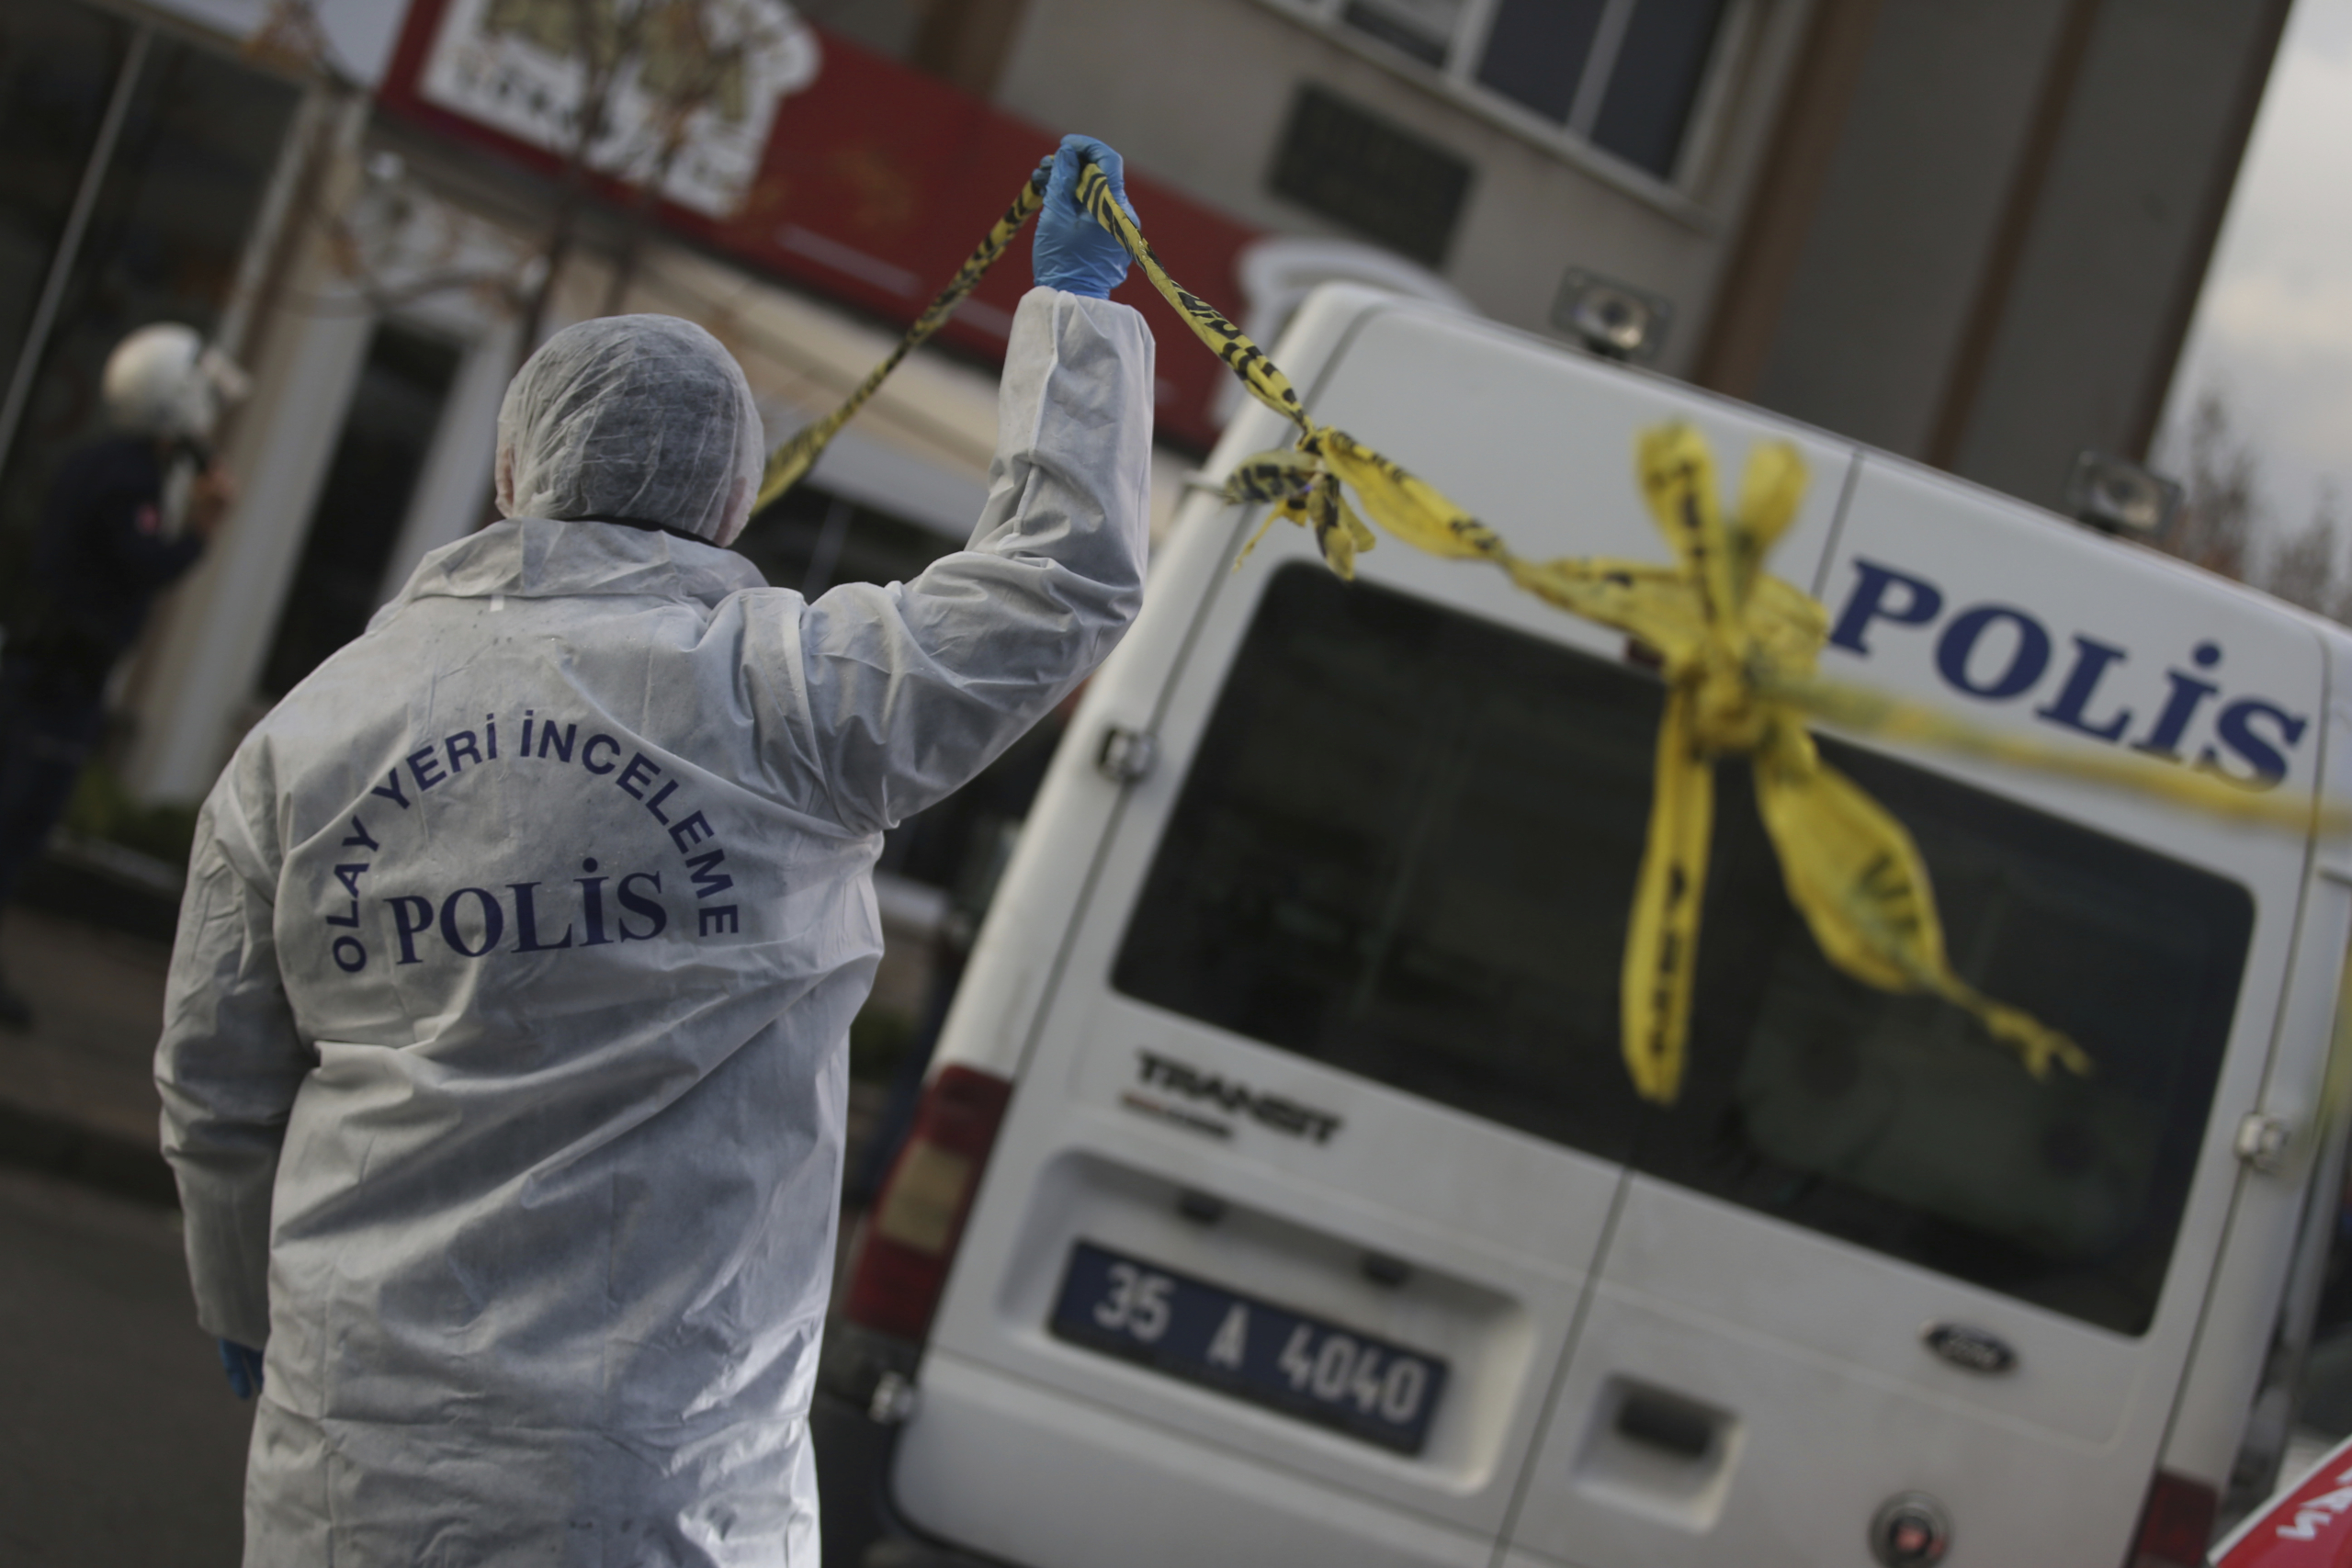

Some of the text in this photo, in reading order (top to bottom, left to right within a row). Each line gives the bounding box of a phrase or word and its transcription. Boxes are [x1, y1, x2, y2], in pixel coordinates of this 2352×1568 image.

[1826, 556, 2309, 794] POLİS
[326, 709, 740, 974] OLAY YERİ İNCELEME
[382, 857, 668, 965] POLİS
[1092, 1263, 1430, 1424] 35 A 4040
